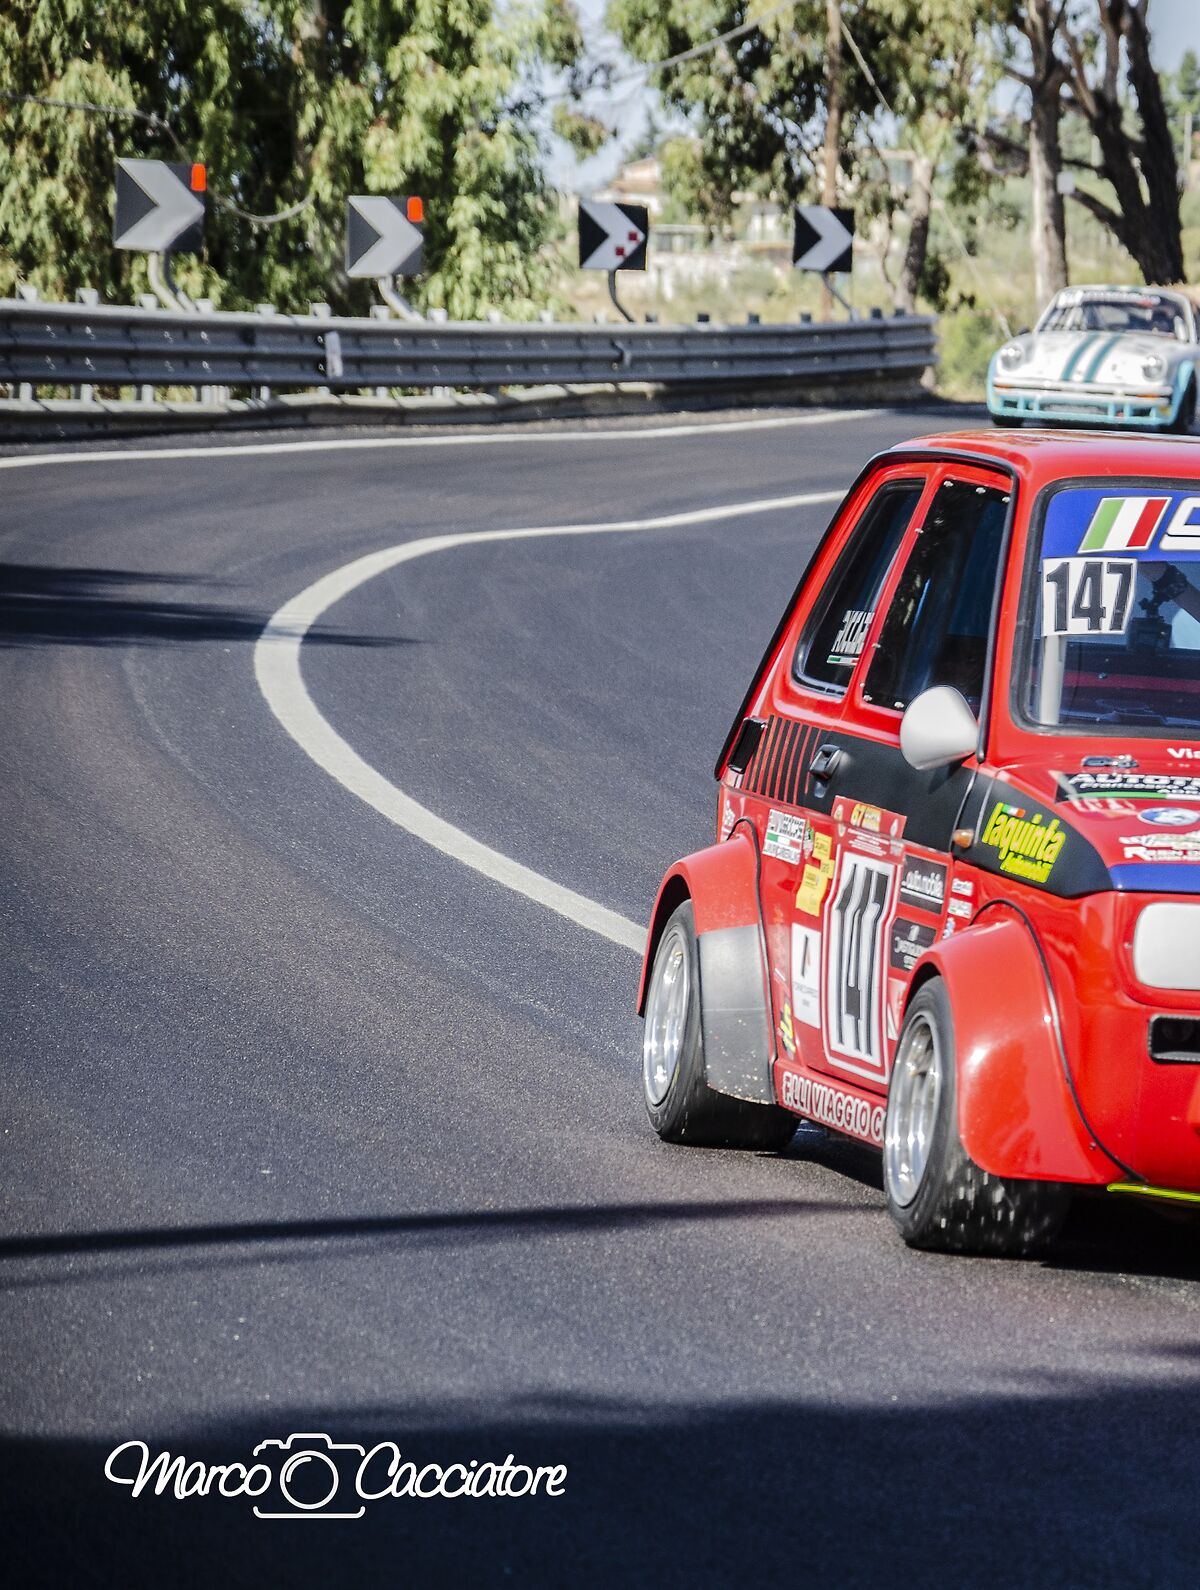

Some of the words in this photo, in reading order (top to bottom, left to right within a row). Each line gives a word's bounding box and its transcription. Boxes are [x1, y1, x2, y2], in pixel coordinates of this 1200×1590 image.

[1045, 560, 1134, 633] 147
[834, 862, 890, 1057] 147
[811, 1082, 871, 1138] VIAGGIO
